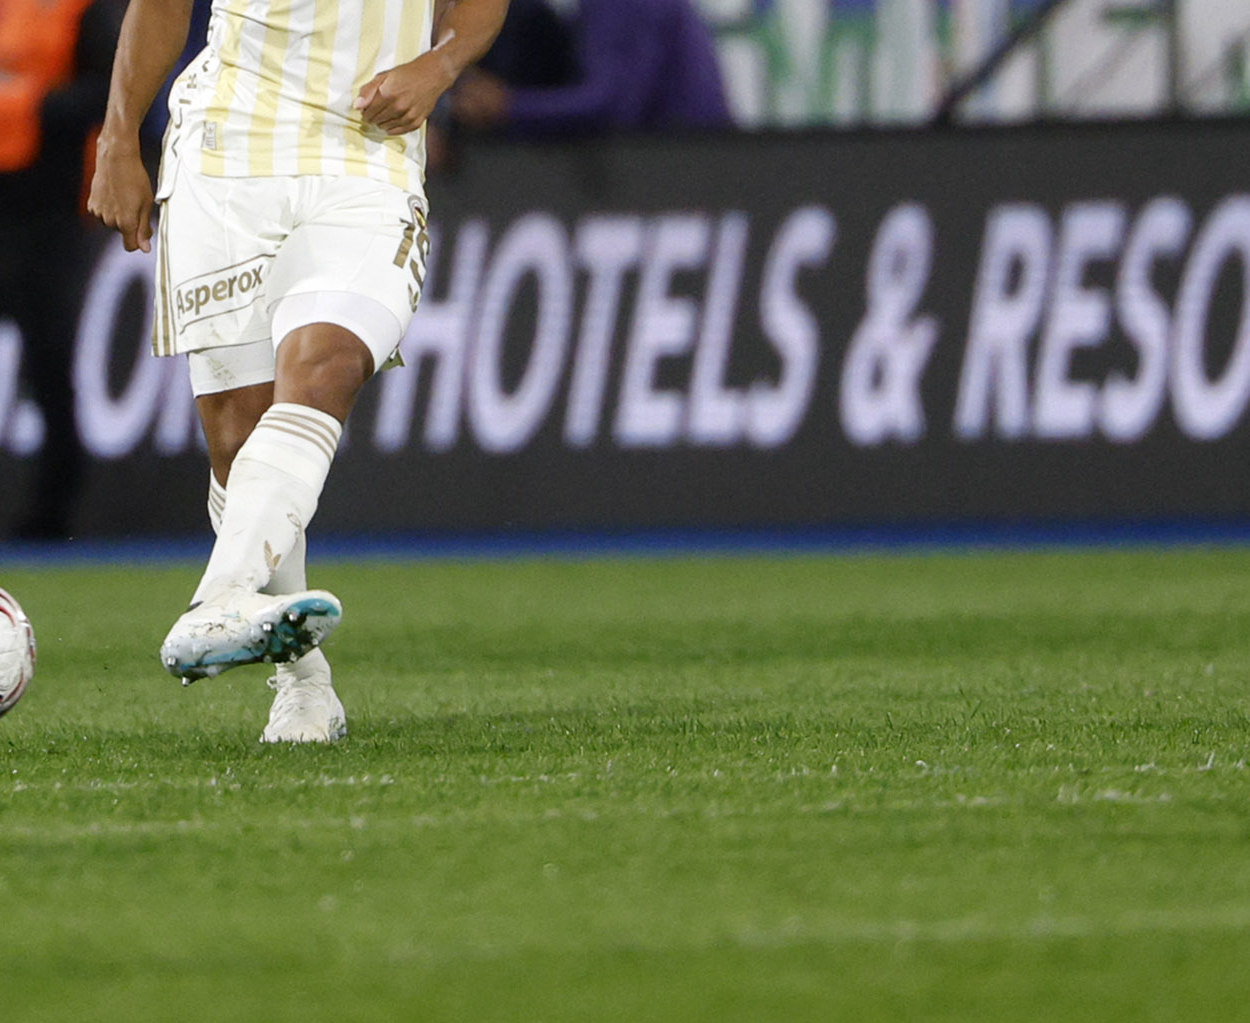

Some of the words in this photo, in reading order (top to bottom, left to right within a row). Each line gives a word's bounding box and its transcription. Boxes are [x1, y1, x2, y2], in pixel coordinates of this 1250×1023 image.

[176, 264, 264, 318] Asperox
[372, 204, 837, 454] HOTELS
[839, 201, 938, 448] &
[953, 193, 1250, 443] RESO
